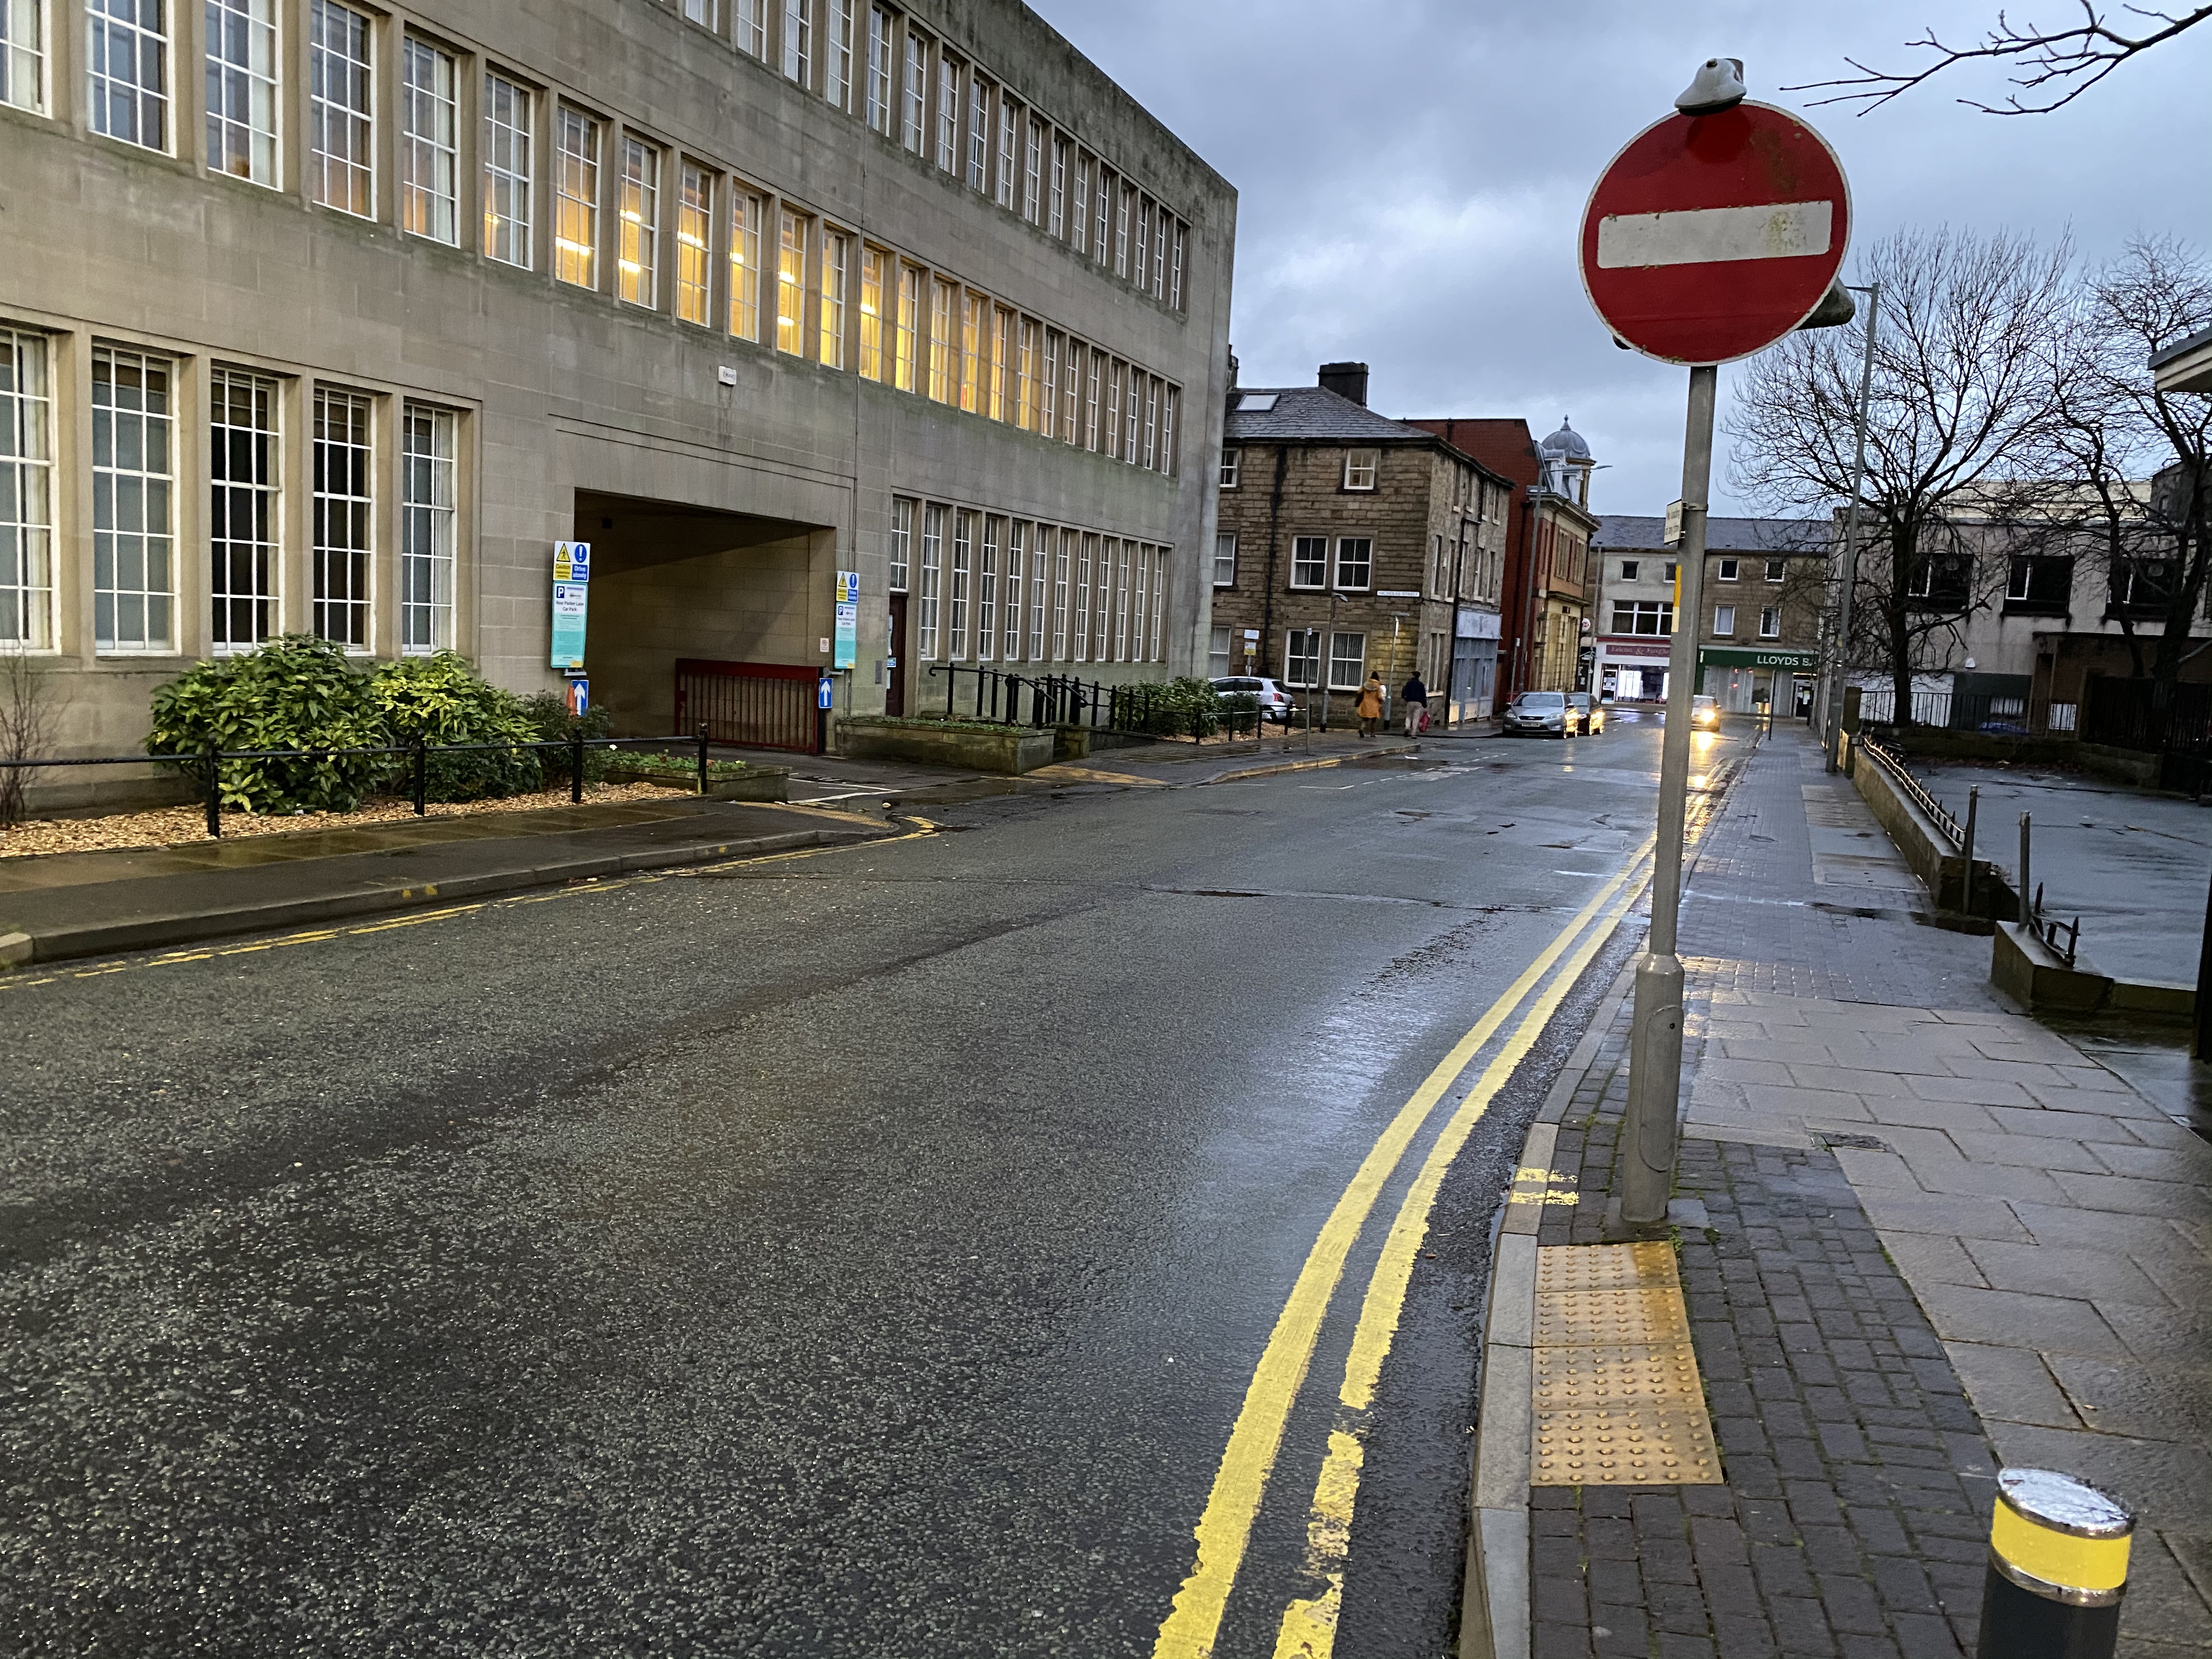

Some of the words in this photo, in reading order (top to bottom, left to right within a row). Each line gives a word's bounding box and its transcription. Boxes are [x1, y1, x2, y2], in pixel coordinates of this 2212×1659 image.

[557, 586, 564, 597] P
[1635, 647, 1645, 656] &
[1757, 655, 1799, 666] LLOYDS
